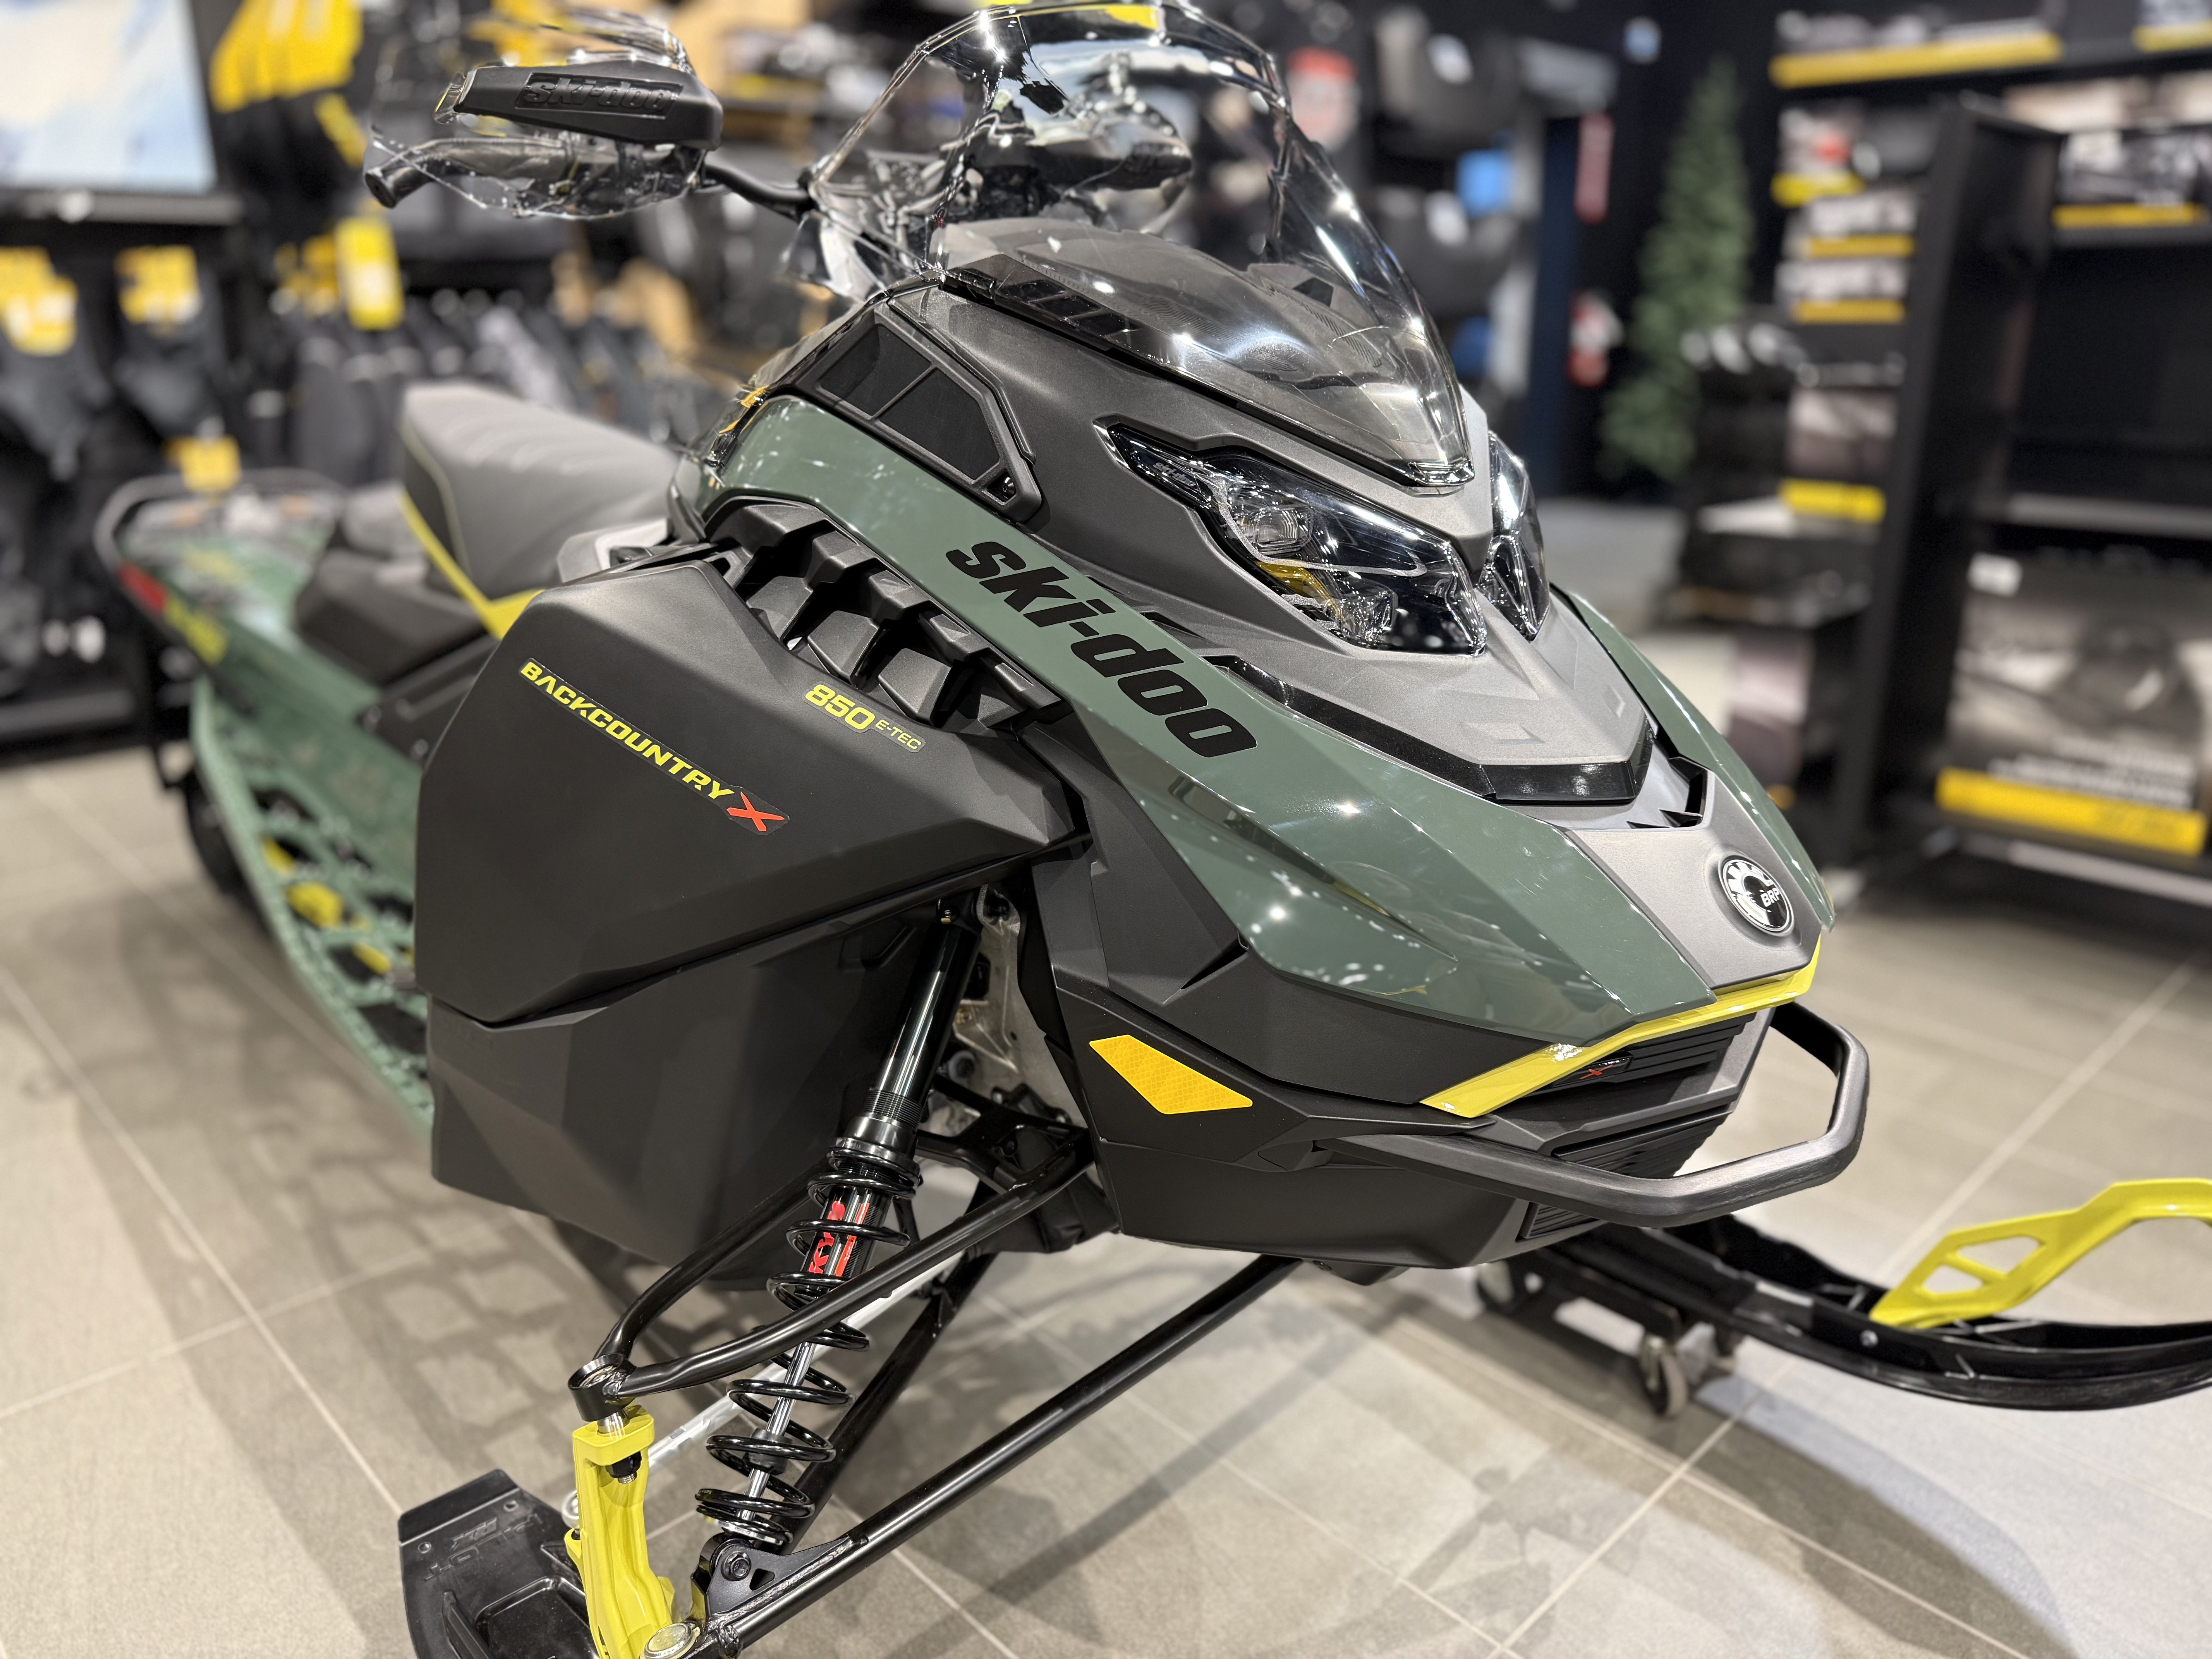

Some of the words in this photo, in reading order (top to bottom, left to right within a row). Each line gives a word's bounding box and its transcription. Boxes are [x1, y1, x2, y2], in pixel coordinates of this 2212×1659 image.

[524, 78, 673, 111] ski-doo
[946, 541, 1257, 757] ski-doo
[520, 662, 735, 799] BACKCOUNTRY
[726, 792, 785, 831] X
[805, 684, 876, 730] 850
[875, 720, 922, 749] E-TEC
[1760, 887, 1780, 907] BRP
